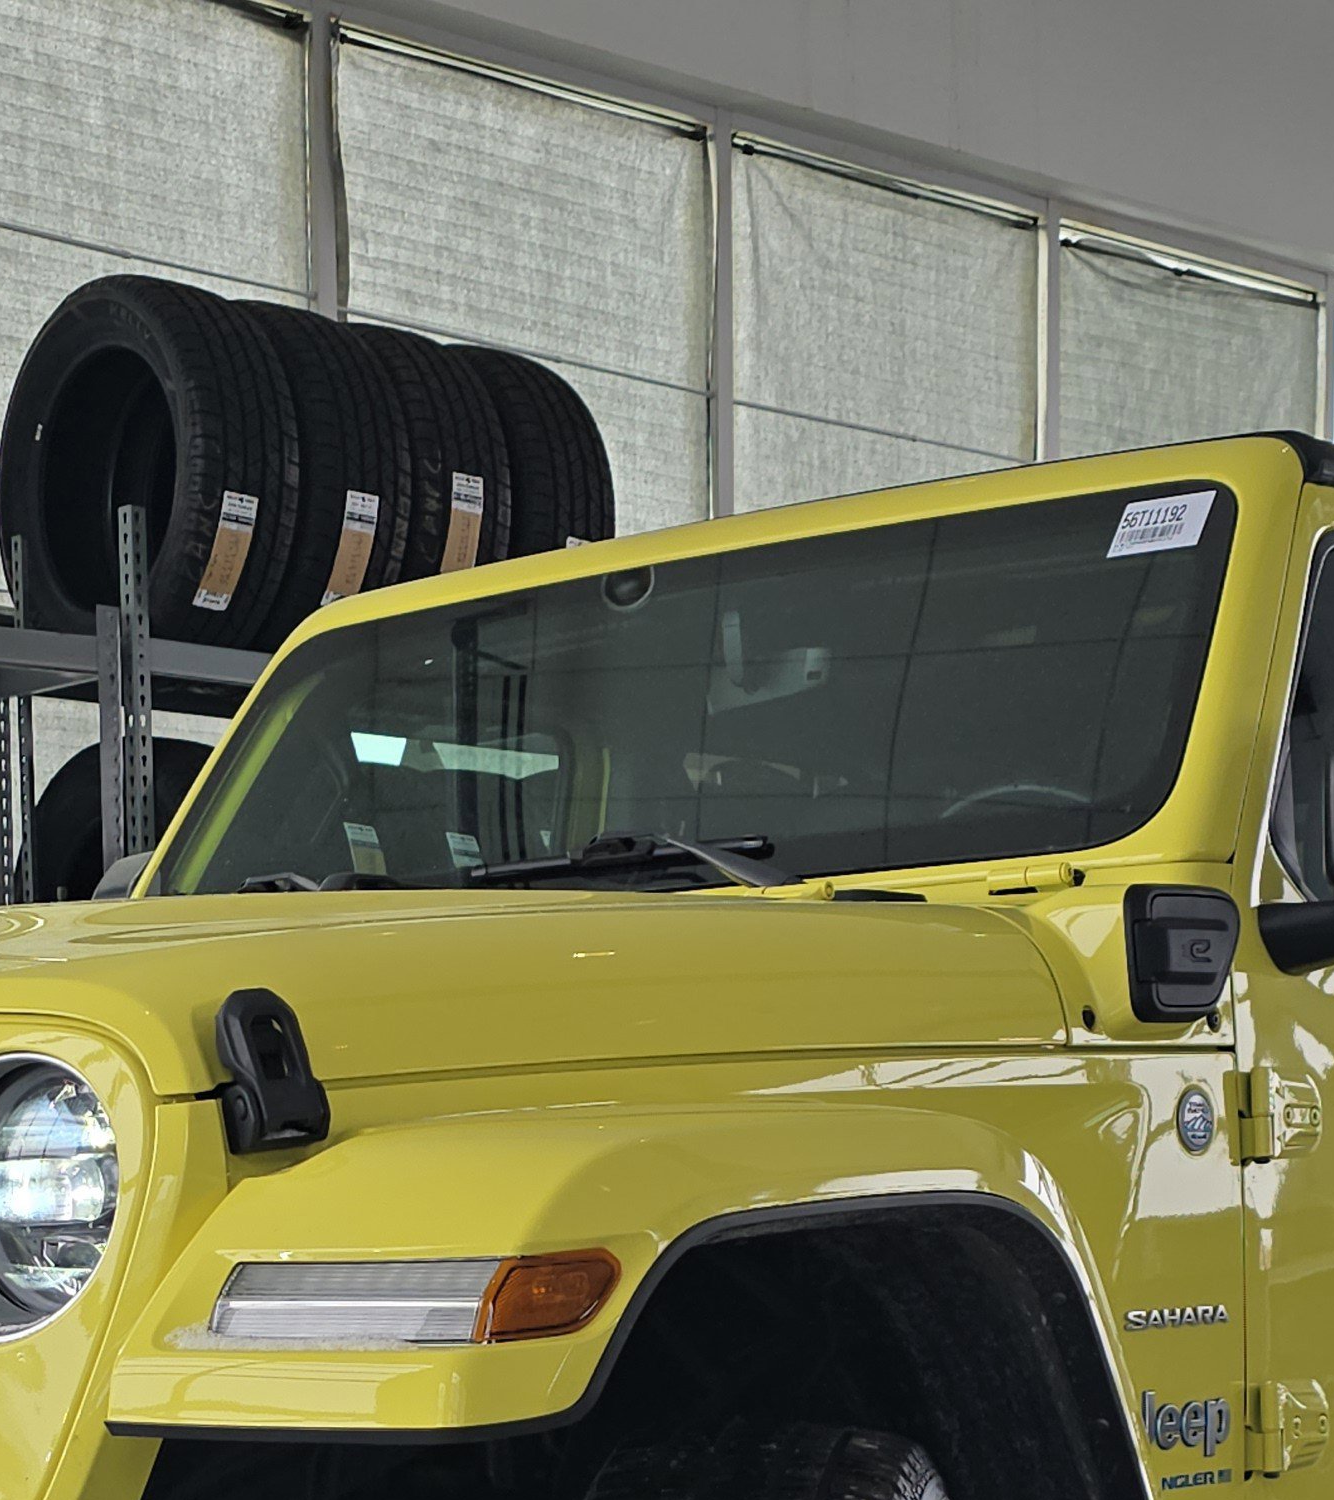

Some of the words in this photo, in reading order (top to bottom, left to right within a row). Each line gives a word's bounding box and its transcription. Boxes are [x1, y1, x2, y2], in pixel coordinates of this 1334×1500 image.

[1124, 1304, 1230, 1331] SAHARA
[1141, 1389, 1231, 1457] Jeep
[1162, 1471, 1216, 1490] NGLER
